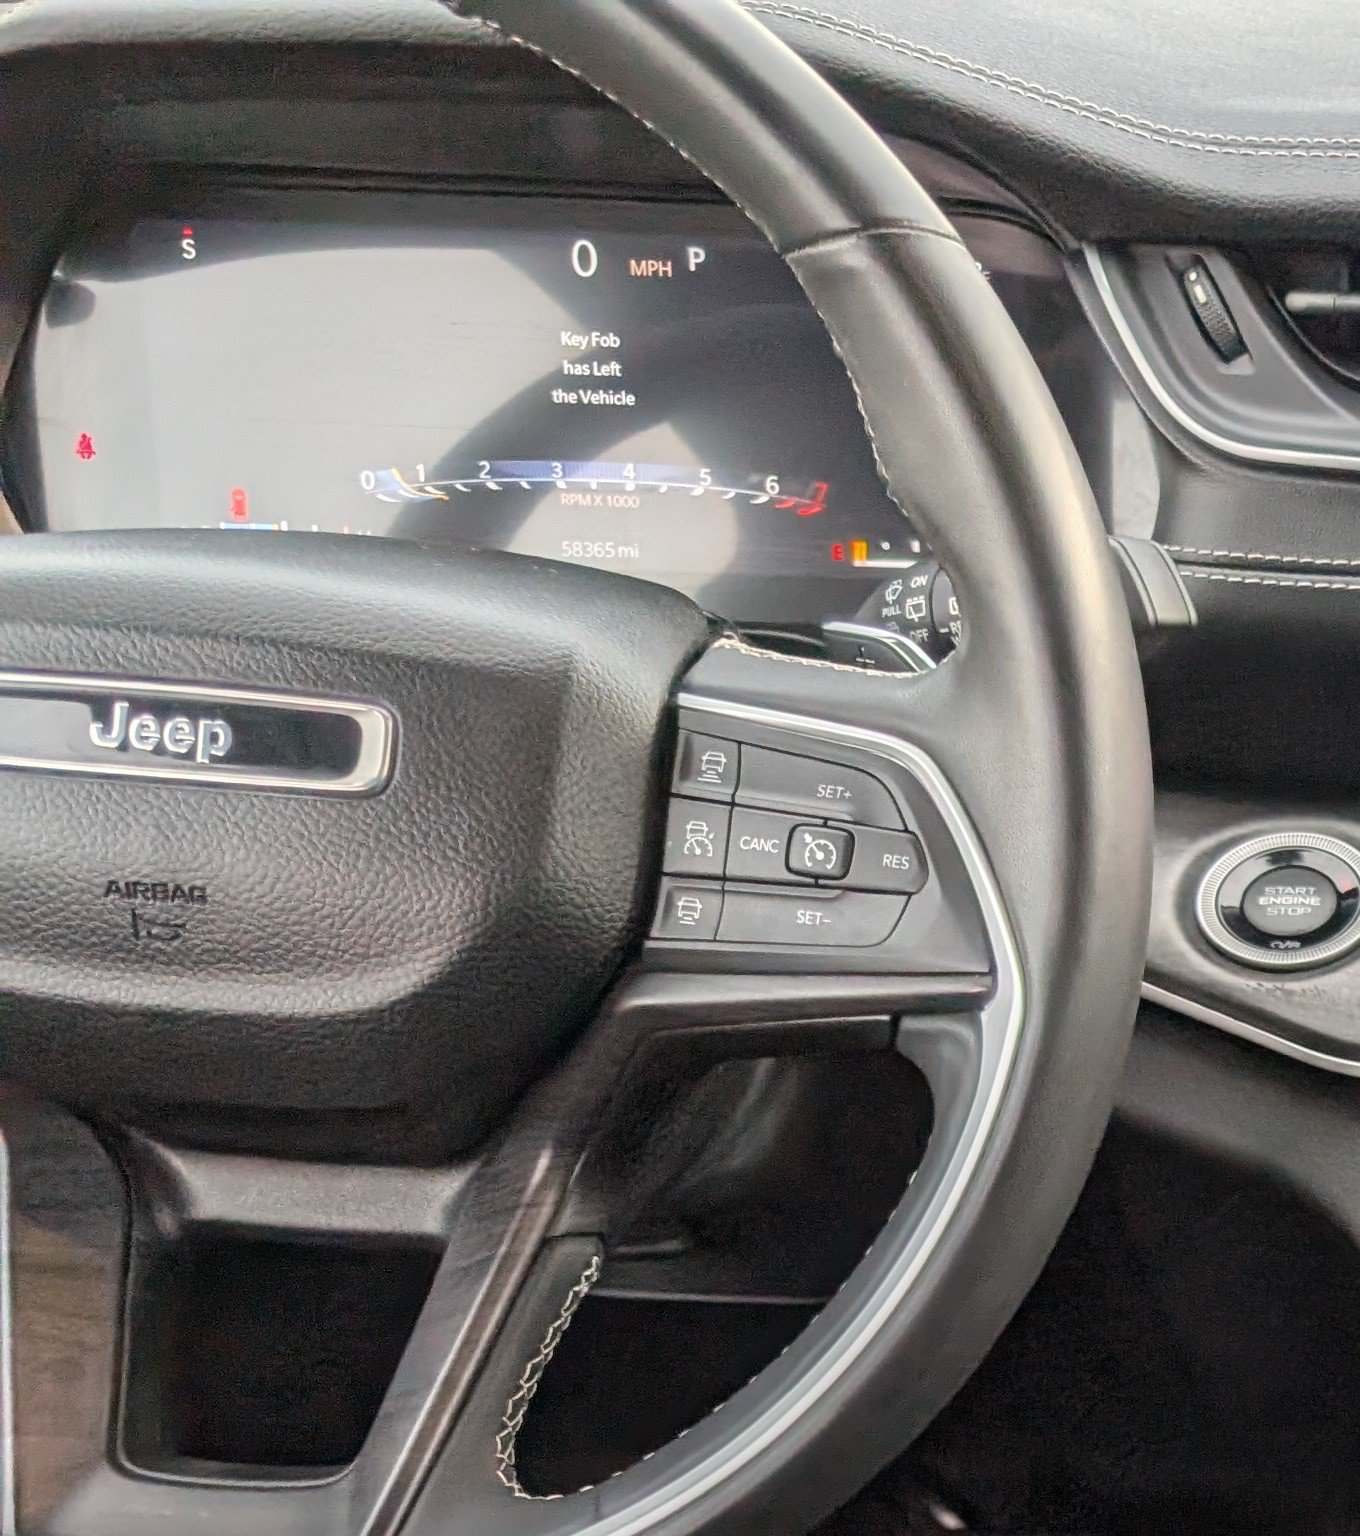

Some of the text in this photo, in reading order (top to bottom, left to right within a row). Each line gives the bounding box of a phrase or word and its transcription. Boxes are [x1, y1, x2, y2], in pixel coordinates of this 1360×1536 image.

[182, 239, 196, 260] S
[571, 238, 673, 278] 0 MPH
[686, 245, 706, 272] P
[560, 331, 621, 350] Key Fob
[563, 360, 622, 377] has Left
[551, 388, 636, 406] the Vehicle
[416, 462, 425, 483] 1
[478, 460, 491, 479] 2
[551, 462, 563, 479] 3
[622, 462, 635, 480] 4
[700, 468, 712, 487] 5
[360, 470, 375, 491] 0
[765, 474, 780, 496] 6
[561, 493, 594, 507] RPM
[607, 494, 639, 508] 1000
[561, 542, 640, 559] 58365 mi
[831, 543, 845, 561] E
[910, 574, 928, 589] ON
[882, 605, 901, 618] PULL
[89, 700, 234, 764] Jeep
[816, 783, 852, 800] SET+
[740, 836, 780, 854] CANC
[882, 853, 910, 870] RES
[103, 879, 209, 905] AIRBAG
[1265, 886, 1318, 896] START
[1258, 896, 1322, 906] ENGINE
[796, 909, 832, 925] SET-
[1267, 906, 1312, 916] STOP
